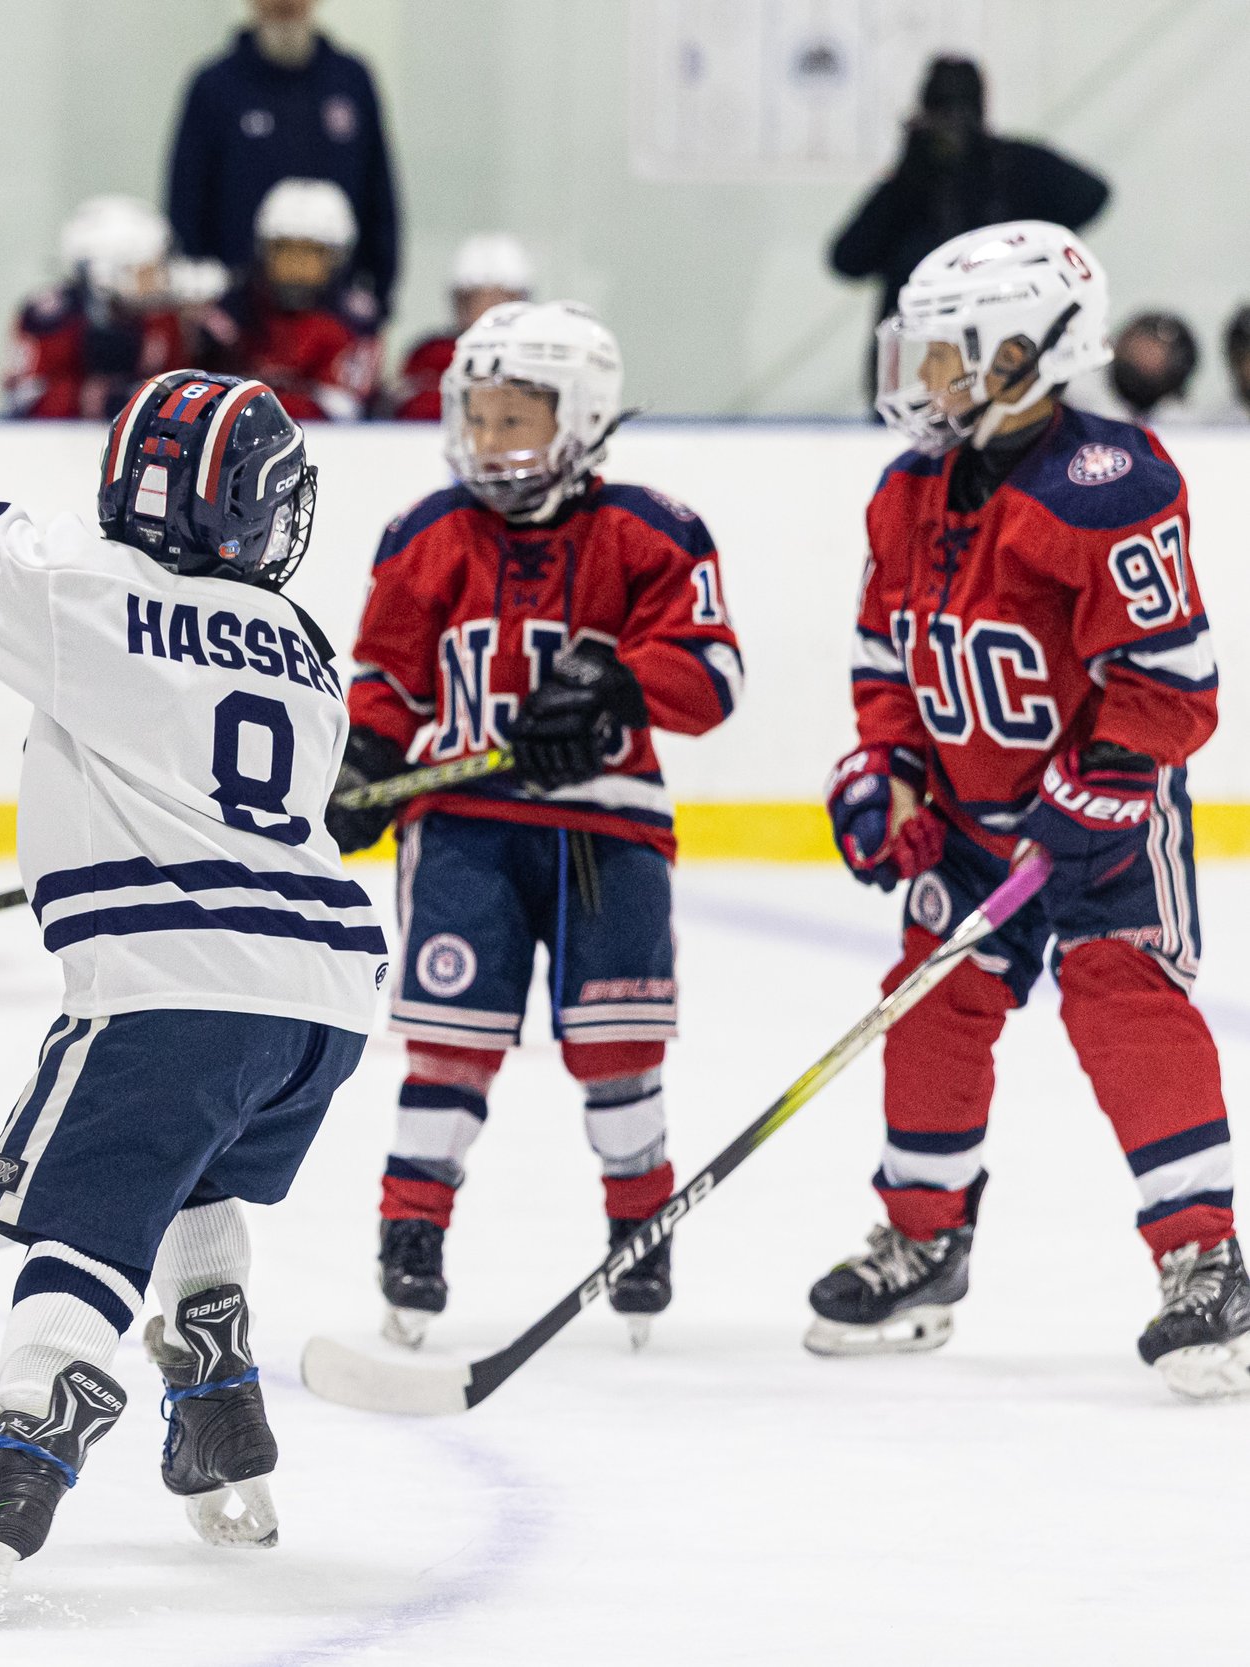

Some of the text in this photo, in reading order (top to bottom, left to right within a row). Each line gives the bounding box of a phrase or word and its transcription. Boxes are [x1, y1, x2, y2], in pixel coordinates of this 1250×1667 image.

[181, 384, 210, 399] 8
[1107, 514, 1192, 631] 97
[208, 689, 312, 848] 8
[68, 1371, 124, 1413] BAUER
